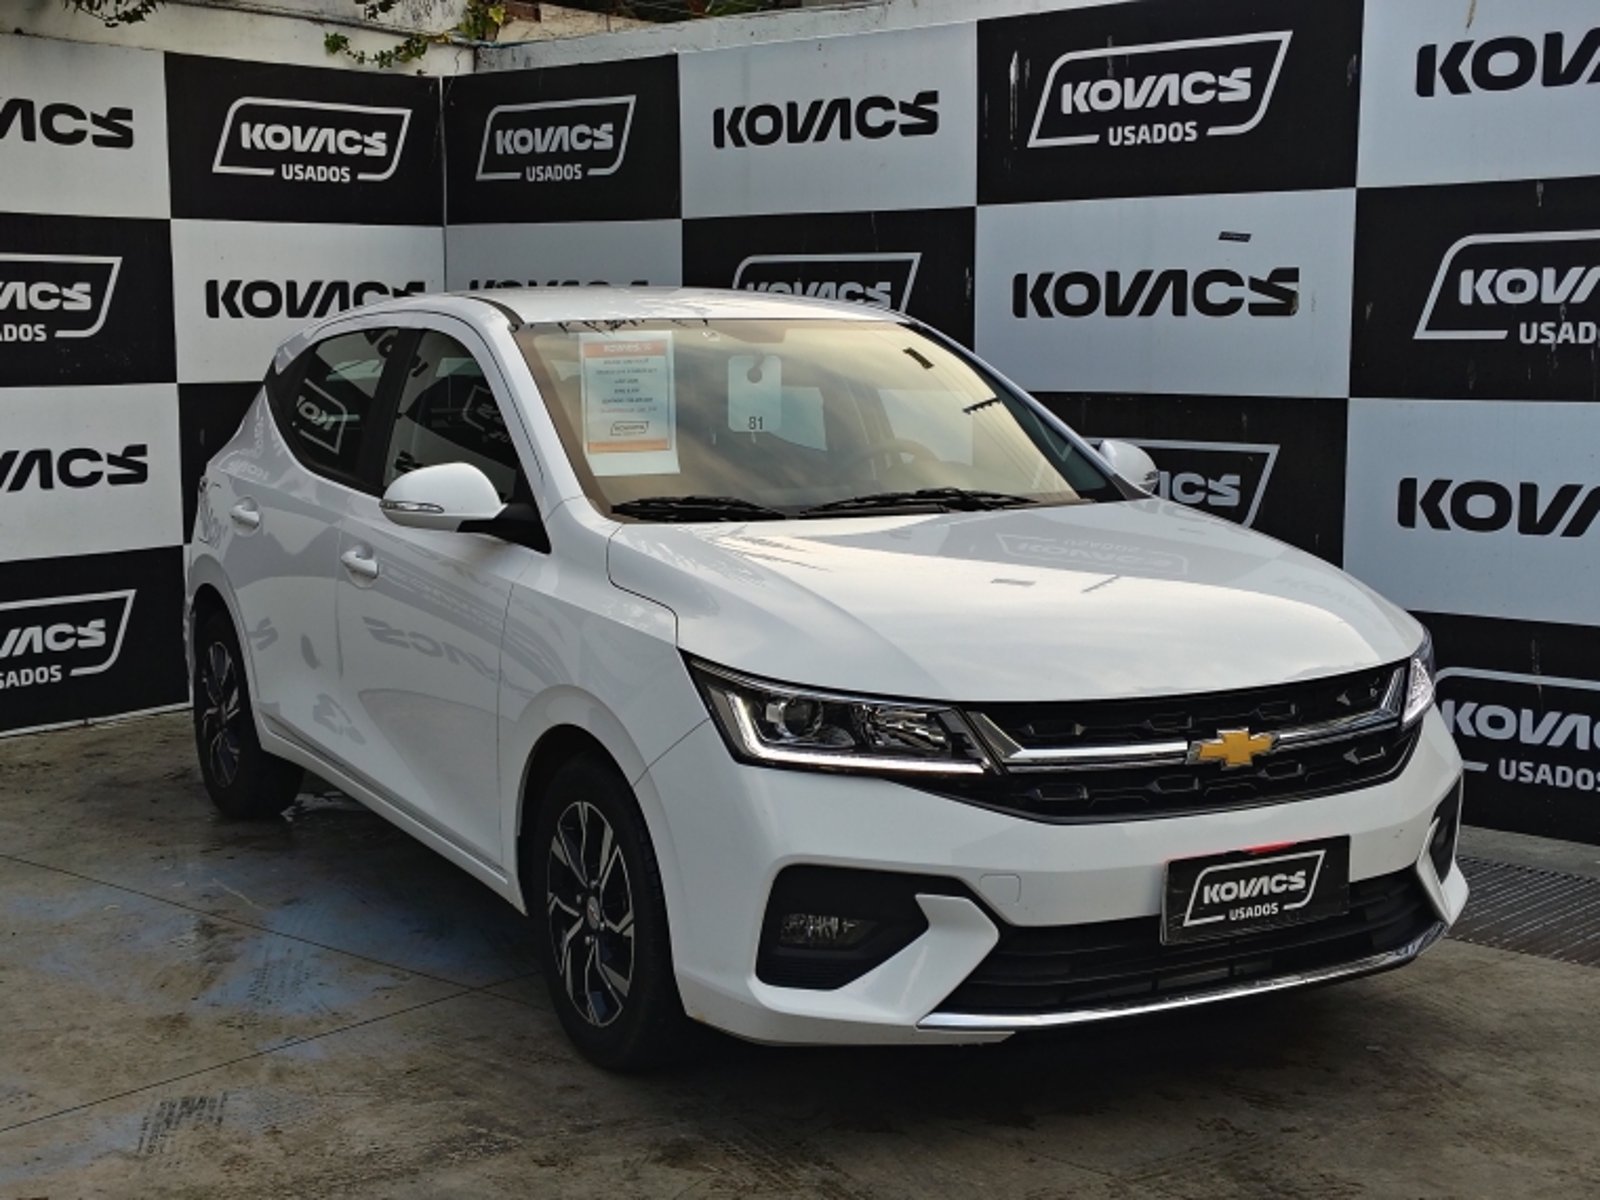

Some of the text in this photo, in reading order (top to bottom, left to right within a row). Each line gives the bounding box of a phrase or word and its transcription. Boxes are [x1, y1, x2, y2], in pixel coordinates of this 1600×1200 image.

[1416, 27, 1600, 97] KOV
[1061, 66, 1252, 115] KOVACS
[0, 97, 133, 149] ACS
[713, 90, 938, 149] KOVACS
[1109, 121, 1198, 146] USADOS
[240, 122, 387, 157] KOVACS
[496, 122, 614, 155] KOVACS
[281, 163, 351, 183] USADOS
[525, 163, 583, 182] USADOS
[0, 281, 91, 311] ACS
[1012, 267, 1300, 319] KOVACS
[0, 323, 47, 342] DOS
[1519, 321, 1600, 344] USAD
[748, 415, 763, 430] 81
[1499, 757, 1600, 792] USADO
[1203, 870, 1306, 905] KOVACS
[1229, 902, 1279, 921] USADOS
